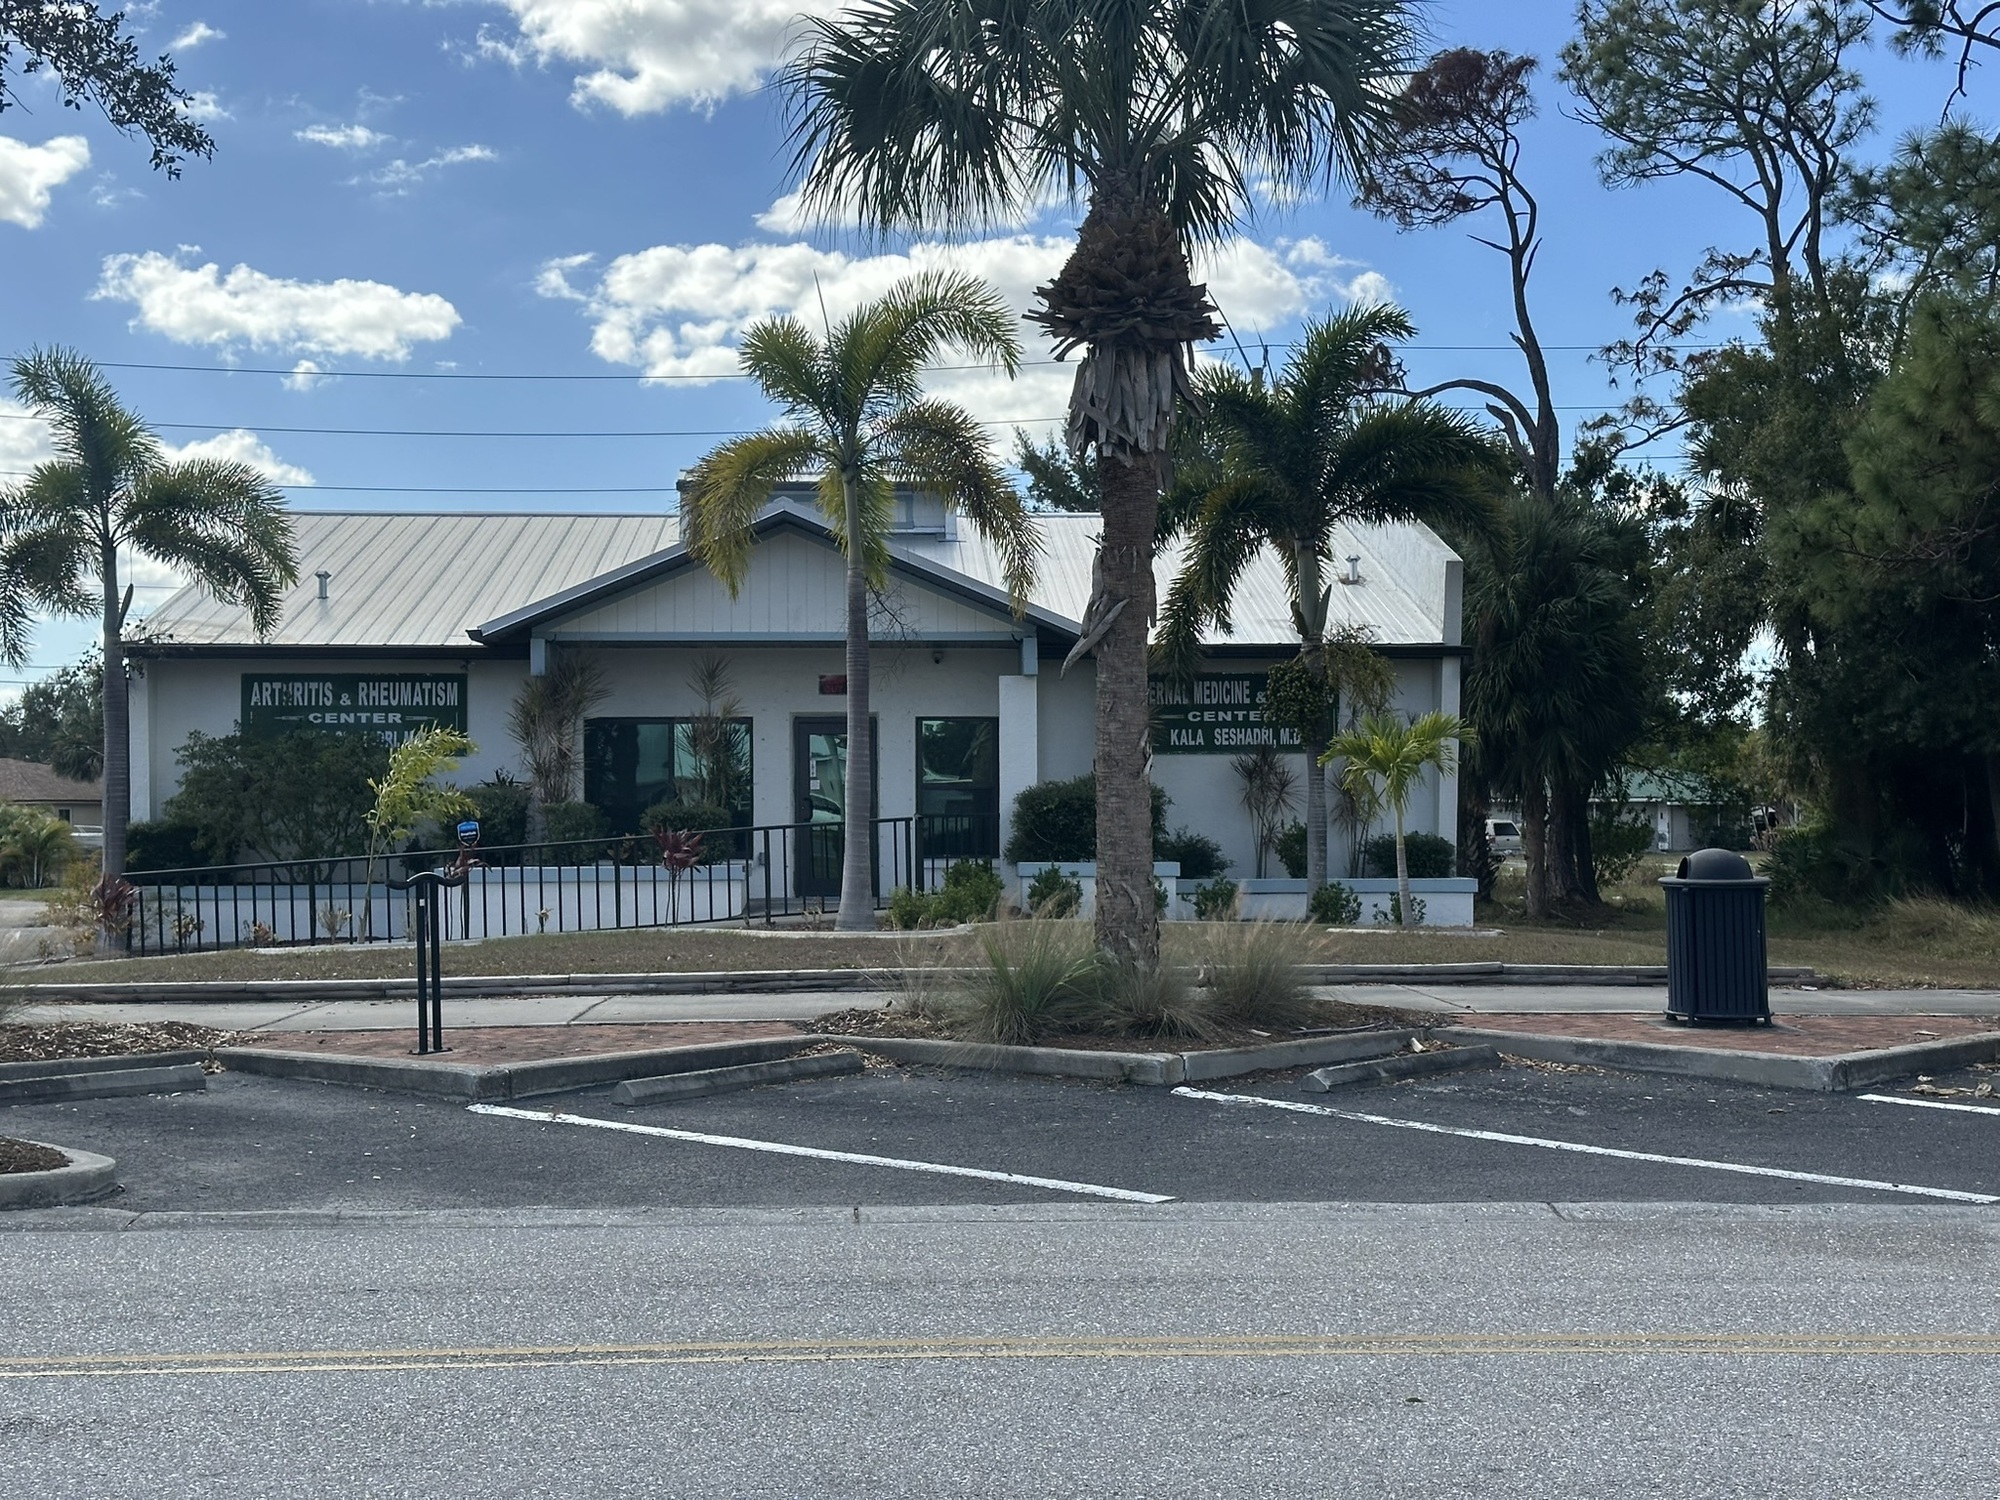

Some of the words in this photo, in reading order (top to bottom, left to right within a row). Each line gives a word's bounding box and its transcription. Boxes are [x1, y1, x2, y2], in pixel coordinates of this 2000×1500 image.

[339, 692, 352, 706] &
[358, 681, 458, 706] RHEUMATISM
[1149, 681, 1189, 705] ERNAL
[1193, 680, 1251, 705] MEDICINE
[1255, 691, 1268, 704] &
[308, 712, 403, 724] CENTER
[1187, 710, 1276, 722] CENTE
[1170, 728, 1205, 746] KALA
[1213, 727, 1277, 749] SESHADRI,
